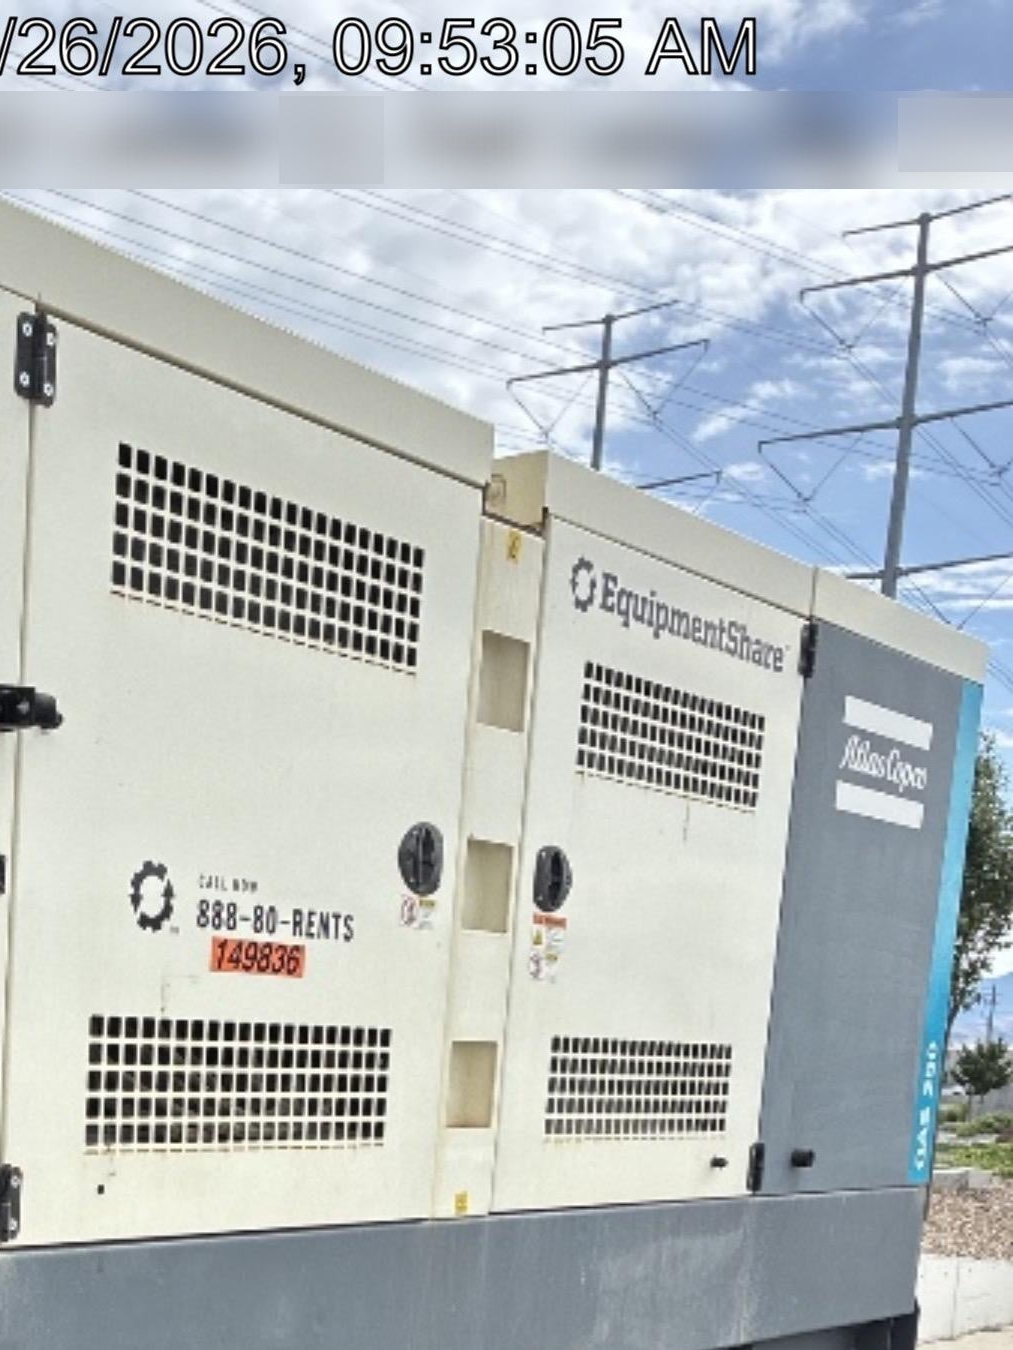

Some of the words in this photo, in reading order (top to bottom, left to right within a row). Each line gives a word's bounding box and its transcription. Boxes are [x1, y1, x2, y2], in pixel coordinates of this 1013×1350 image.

[599, 571, 784, 673] EquipmentShare
[838, 734, 885, 778] Atlas
[886, 748, 927, 793] Copco
[195, 898, 355, 943] 888-80-RENTS
[216, 938, 302, 976] 149836
